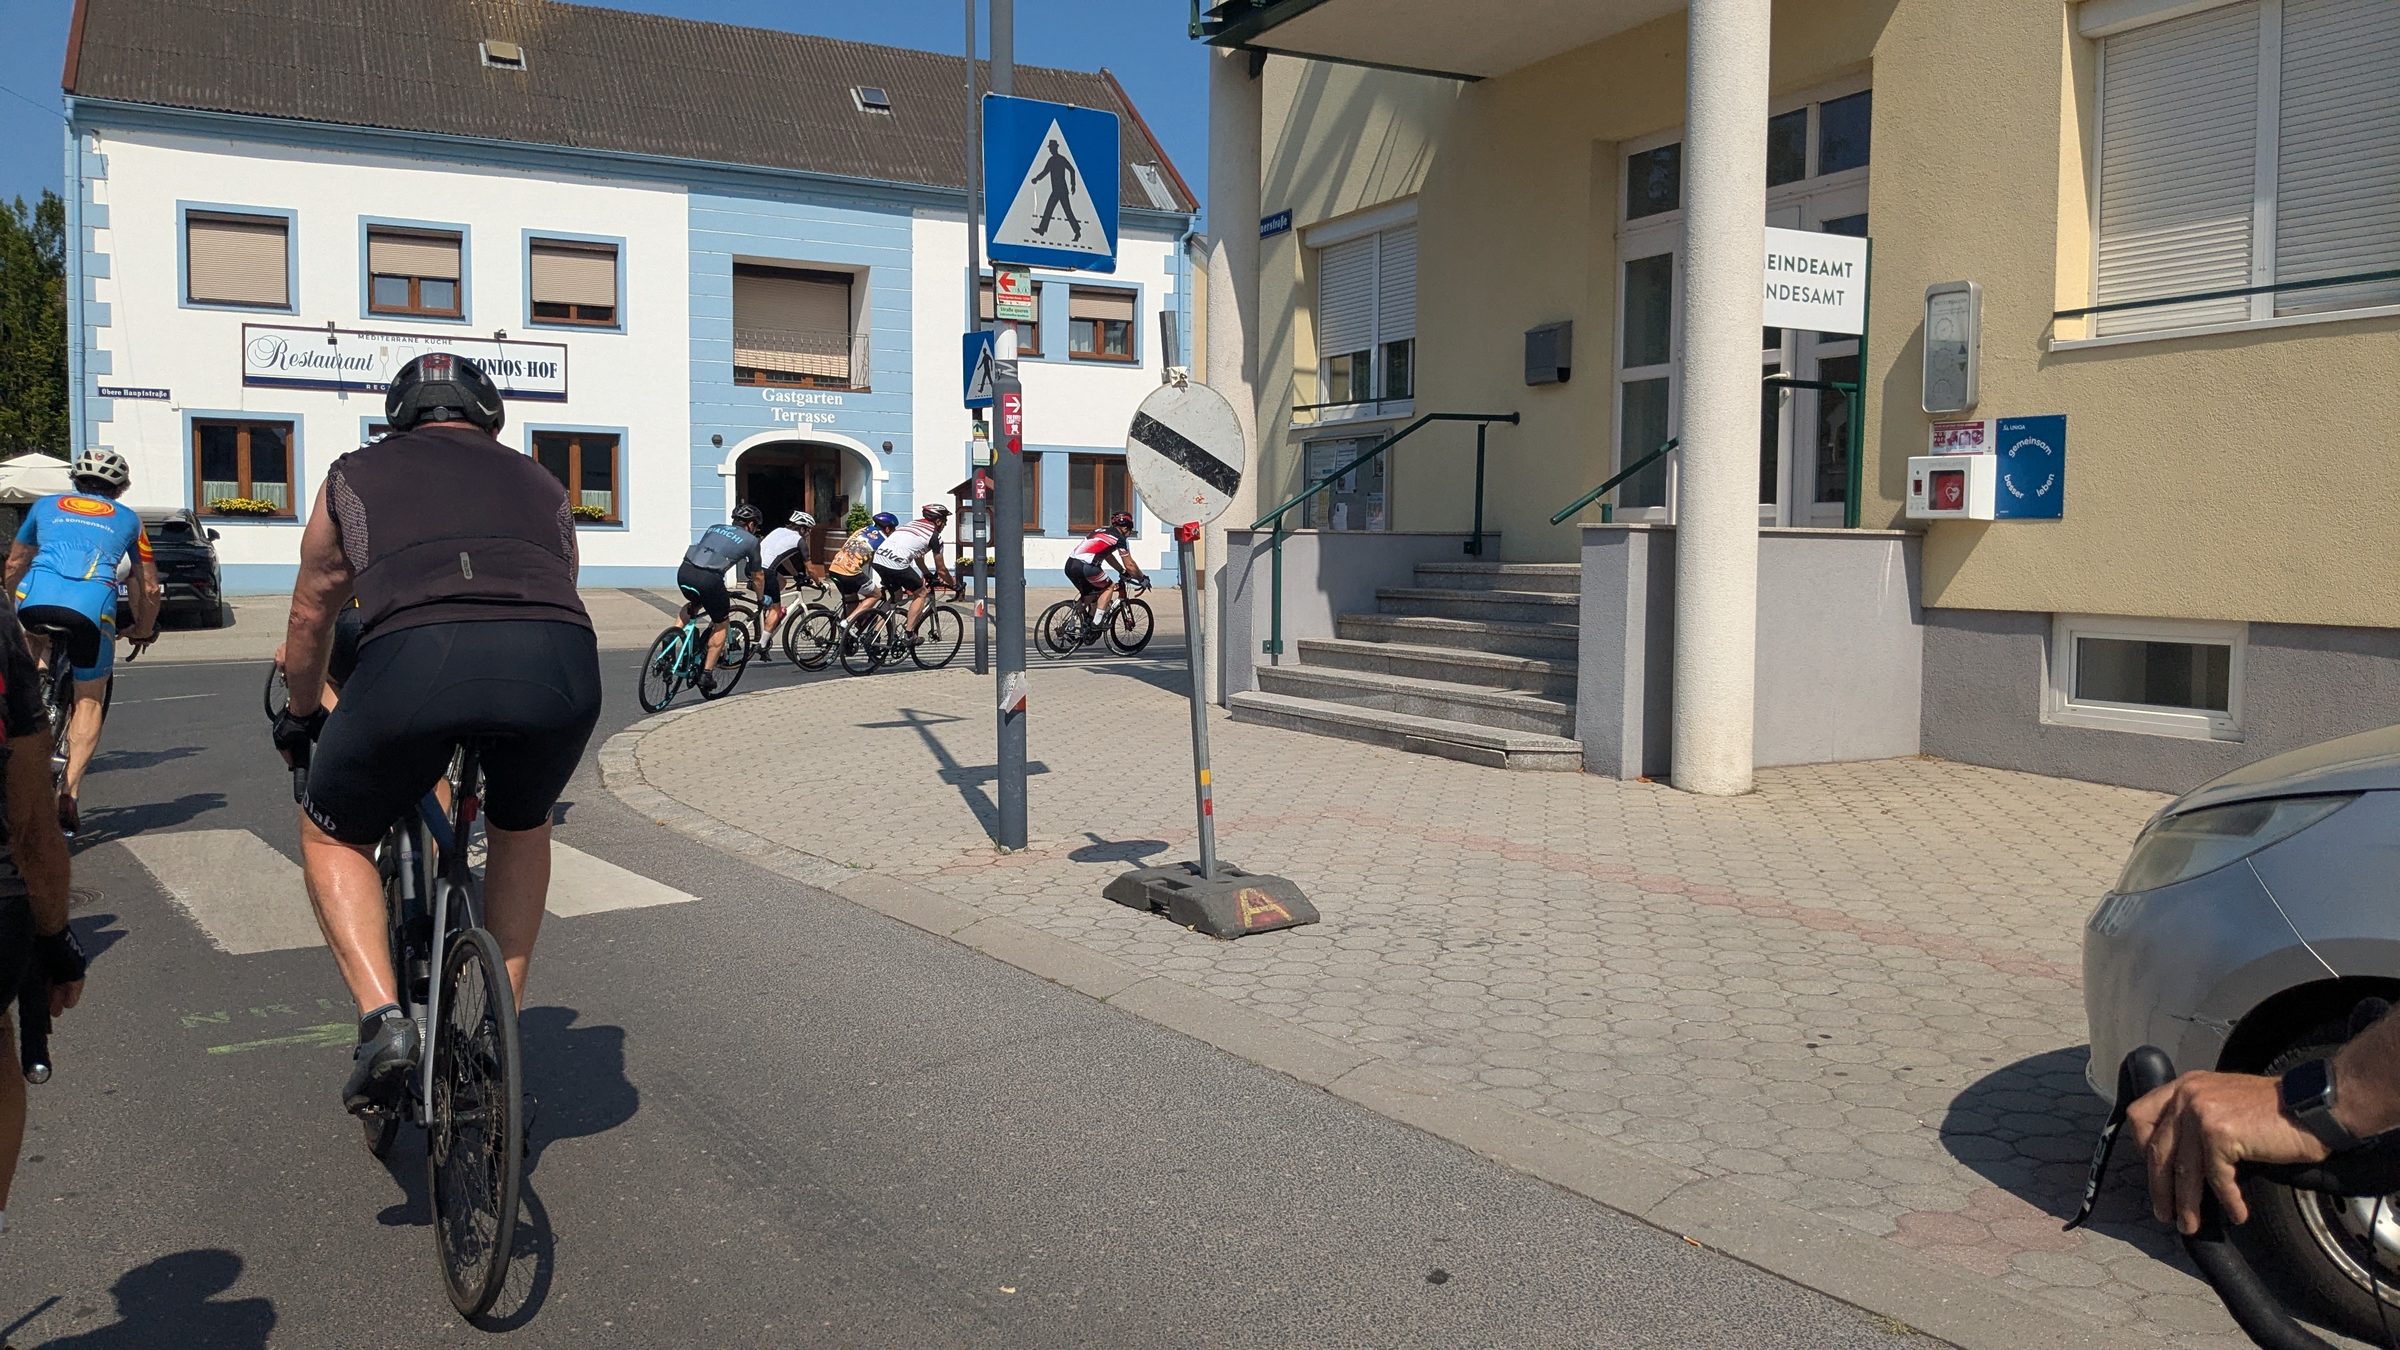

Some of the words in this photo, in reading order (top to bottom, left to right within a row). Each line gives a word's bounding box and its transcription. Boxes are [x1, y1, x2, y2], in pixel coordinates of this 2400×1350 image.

[1763, 253, 1853, 279] EINDEAMT
[1762, 282, 1845, 306] NDESAMT
[357, 333, 419, 343] MEDITERRANE
[247, 334, 374, 371] Restaurant
[467, 357, 558, 379] ONIOS-HOF
[101, 388, 122, 396] Obere
[123, 389, 168, 398] Hauptstraße
[762, 388, 843, 407] Gastgarten
[771, 408, 835, 424] Terrasse
[2008, 436, 2052, 458] gemeinsam
[2004, 474, 2025, 499] besser
[2036, 473, 2055, 497] leben
